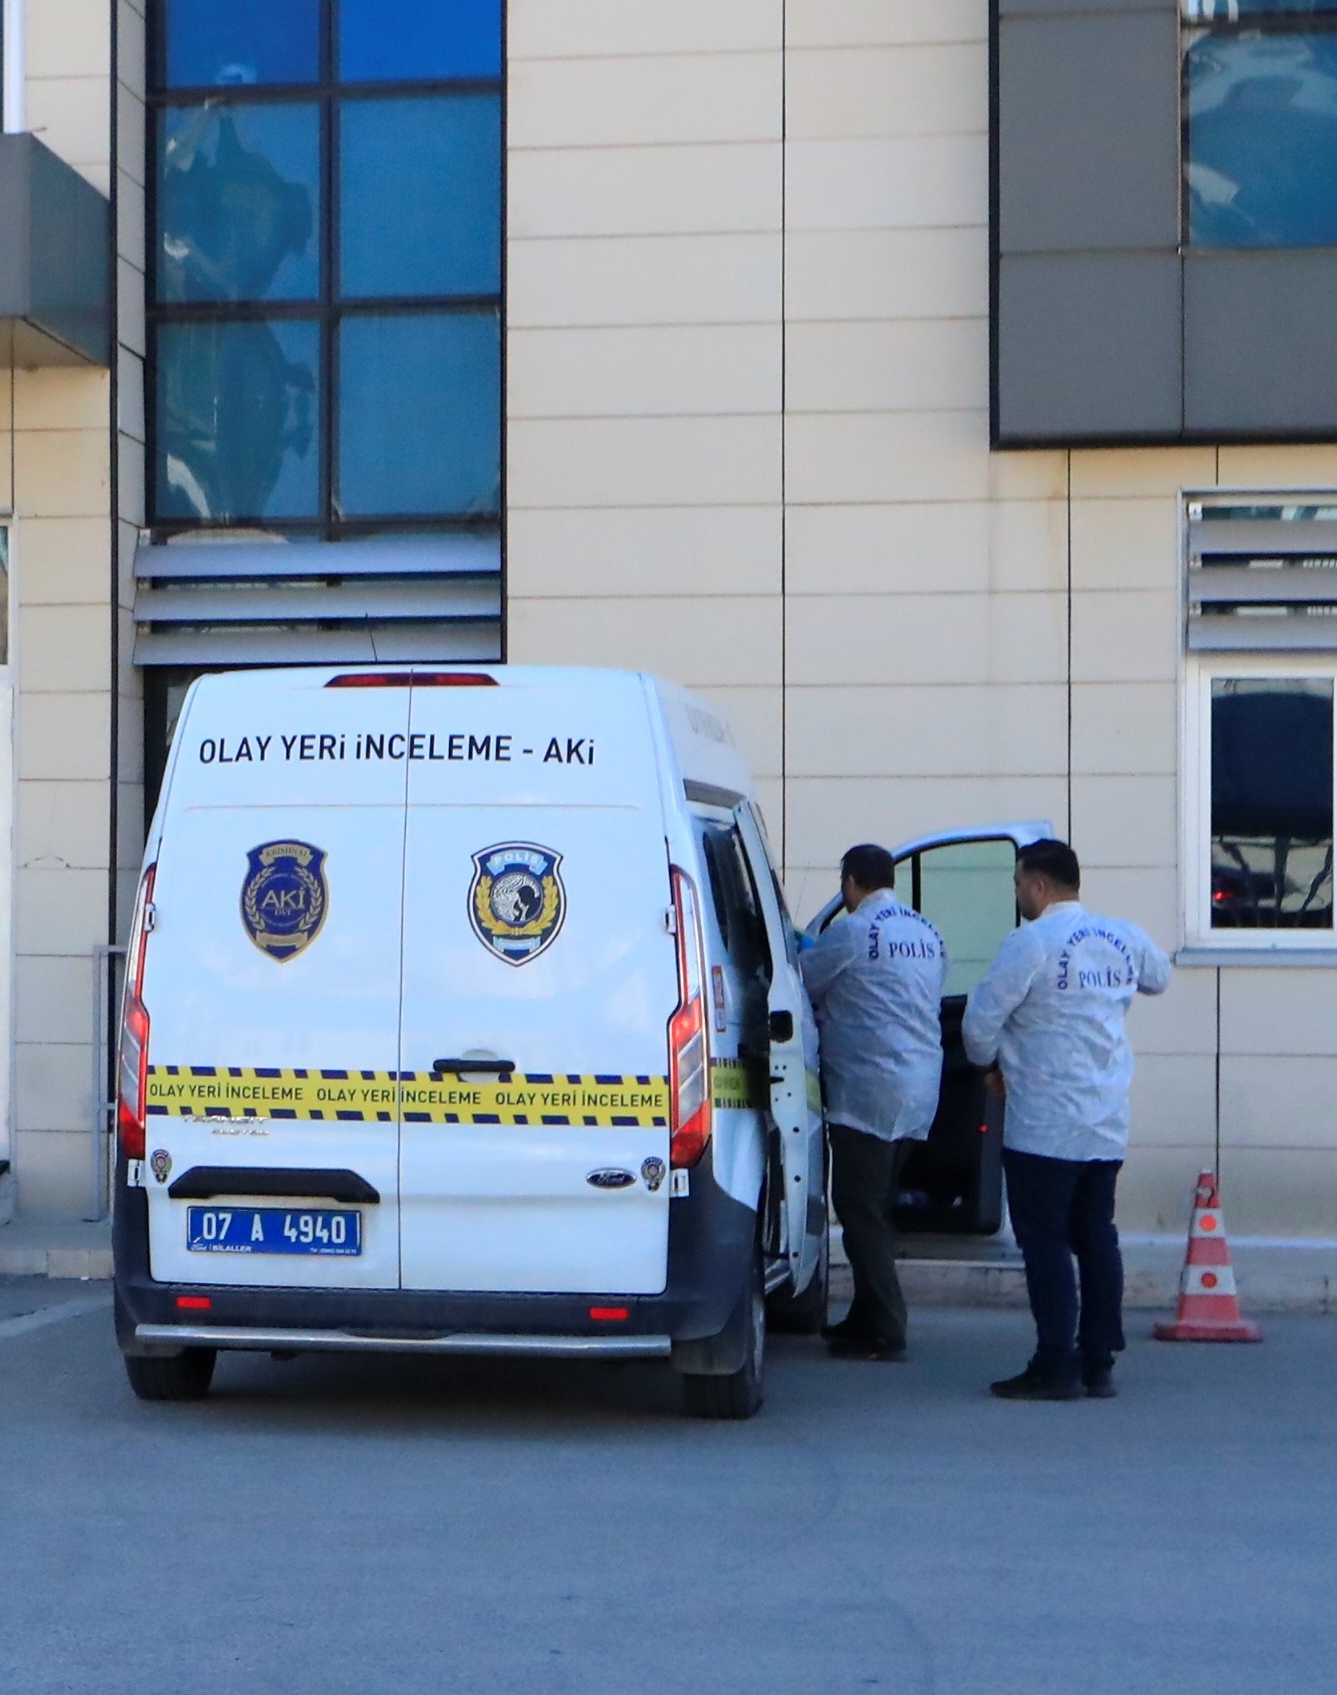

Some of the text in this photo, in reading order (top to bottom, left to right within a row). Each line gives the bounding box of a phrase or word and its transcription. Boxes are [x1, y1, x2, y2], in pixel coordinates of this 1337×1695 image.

[199, 736, 272, 764] OLAY
[261, 887, 305, 909] AKİ
[889, 938, 935, 959] POLİS
[1057, 949, 1071, 990] OLAY
[1079, 965, 1121, 989] POLİS
[150, 1083, 303, 1101] OLAY YERİ İNCELEME
[317, 1087, 481, 1105] OLAY YERİ İNCELEME
[495, 1090, 663, 1107] OLAY YERİ İNCELEME
[203, 1213, 346, 1244] 07 A 4940
